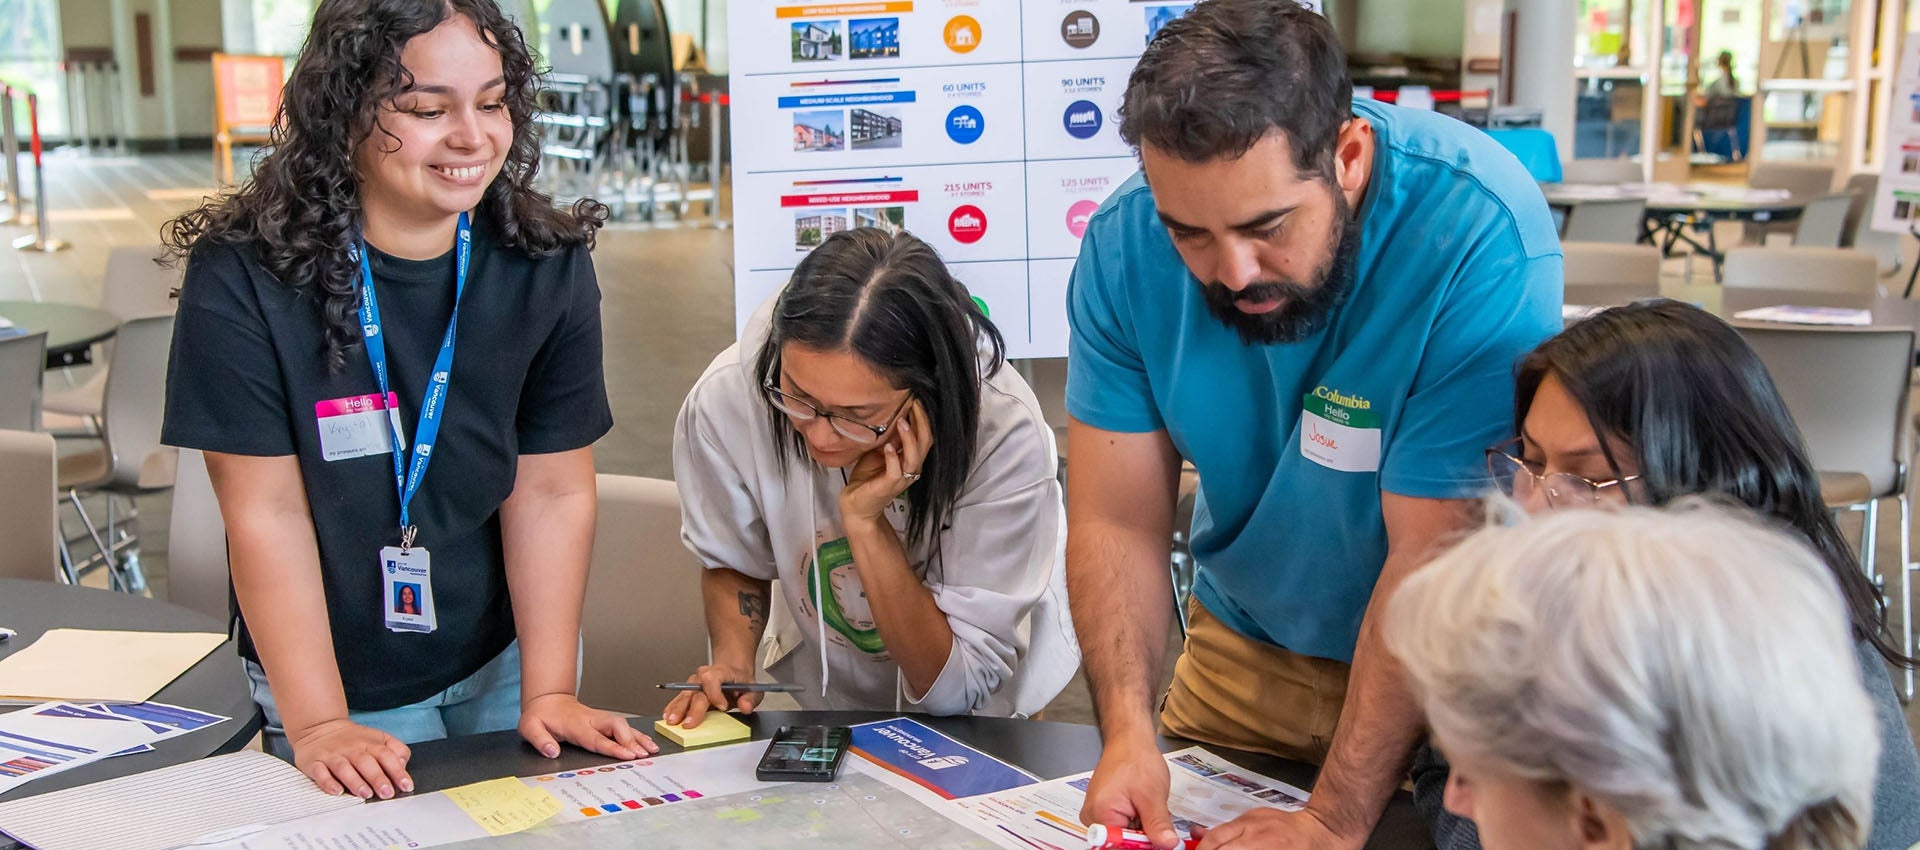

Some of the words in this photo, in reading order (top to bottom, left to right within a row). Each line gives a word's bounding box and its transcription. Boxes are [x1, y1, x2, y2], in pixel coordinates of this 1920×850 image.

[943, 84, 954, 92] 60
[956, 82, 986, 91] UNITS
[1061, 79, 1073, 87] 90
[1075, 77, 1105, 86] UNITS
[944, 183, 960, 192] 215
[962, 182, 993, 191] UNITS
[1061, 179, 1077, 187] 125
[1079, 177, 1109, 186] UNITS
[428, 384, 442, 420] Vancouver
[1316, 386, 1370, 409] Columbia
[345, 398, 373, 409] Hello
[1324, 403, 1350, 420] Hello
[397, 564, 427, 573] Vancouver
[872, 727, 936, 759] Vancouver
